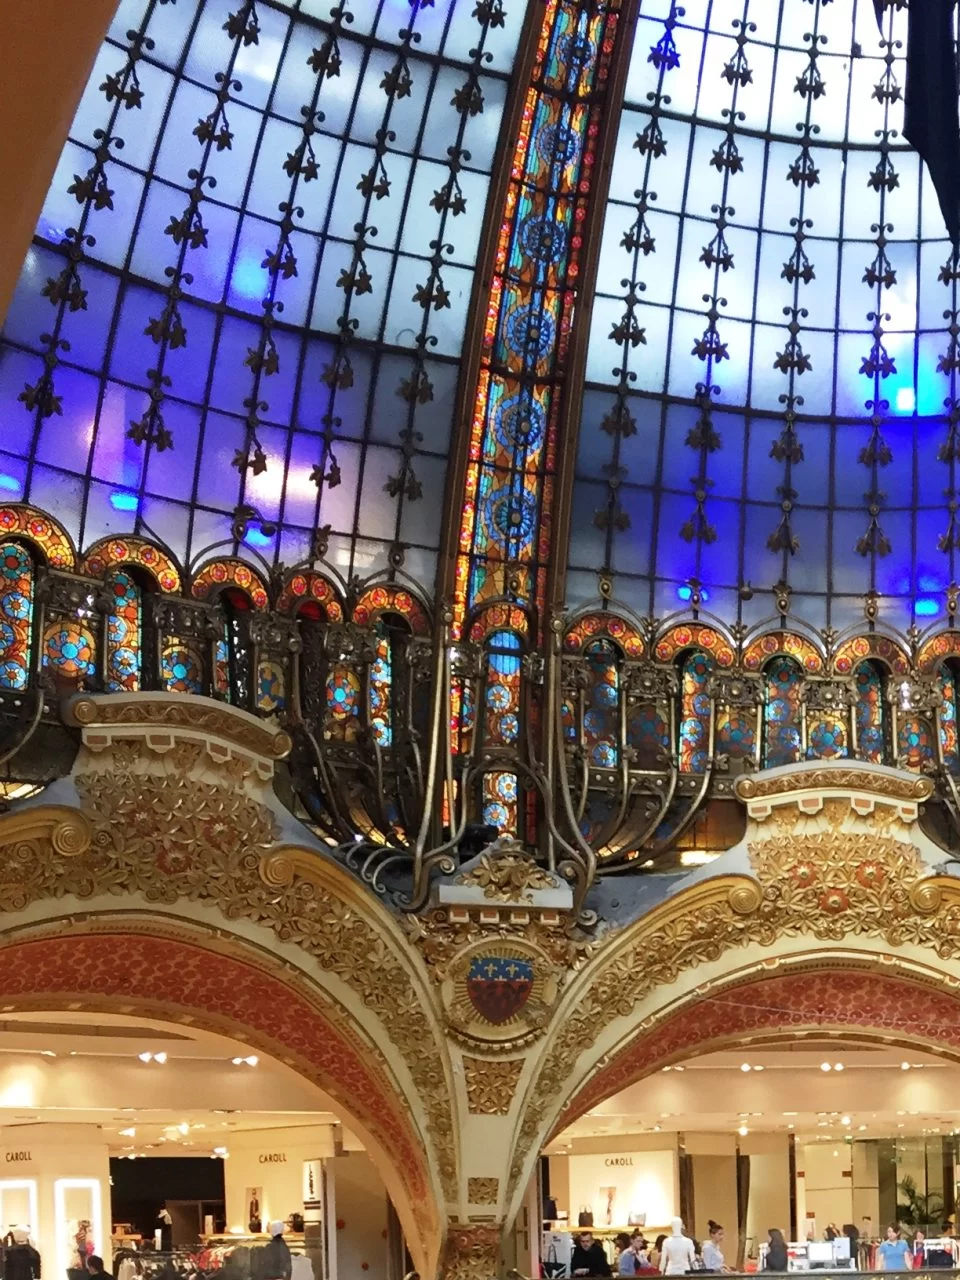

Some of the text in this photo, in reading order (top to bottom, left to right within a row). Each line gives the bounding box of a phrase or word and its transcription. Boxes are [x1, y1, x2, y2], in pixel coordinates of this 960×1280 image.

[5, 1152, 32, 1162] CAROLL
[258, 1153, 287, 1163] CAROLL
[605, 1157, 634, 1167] CAROLL
